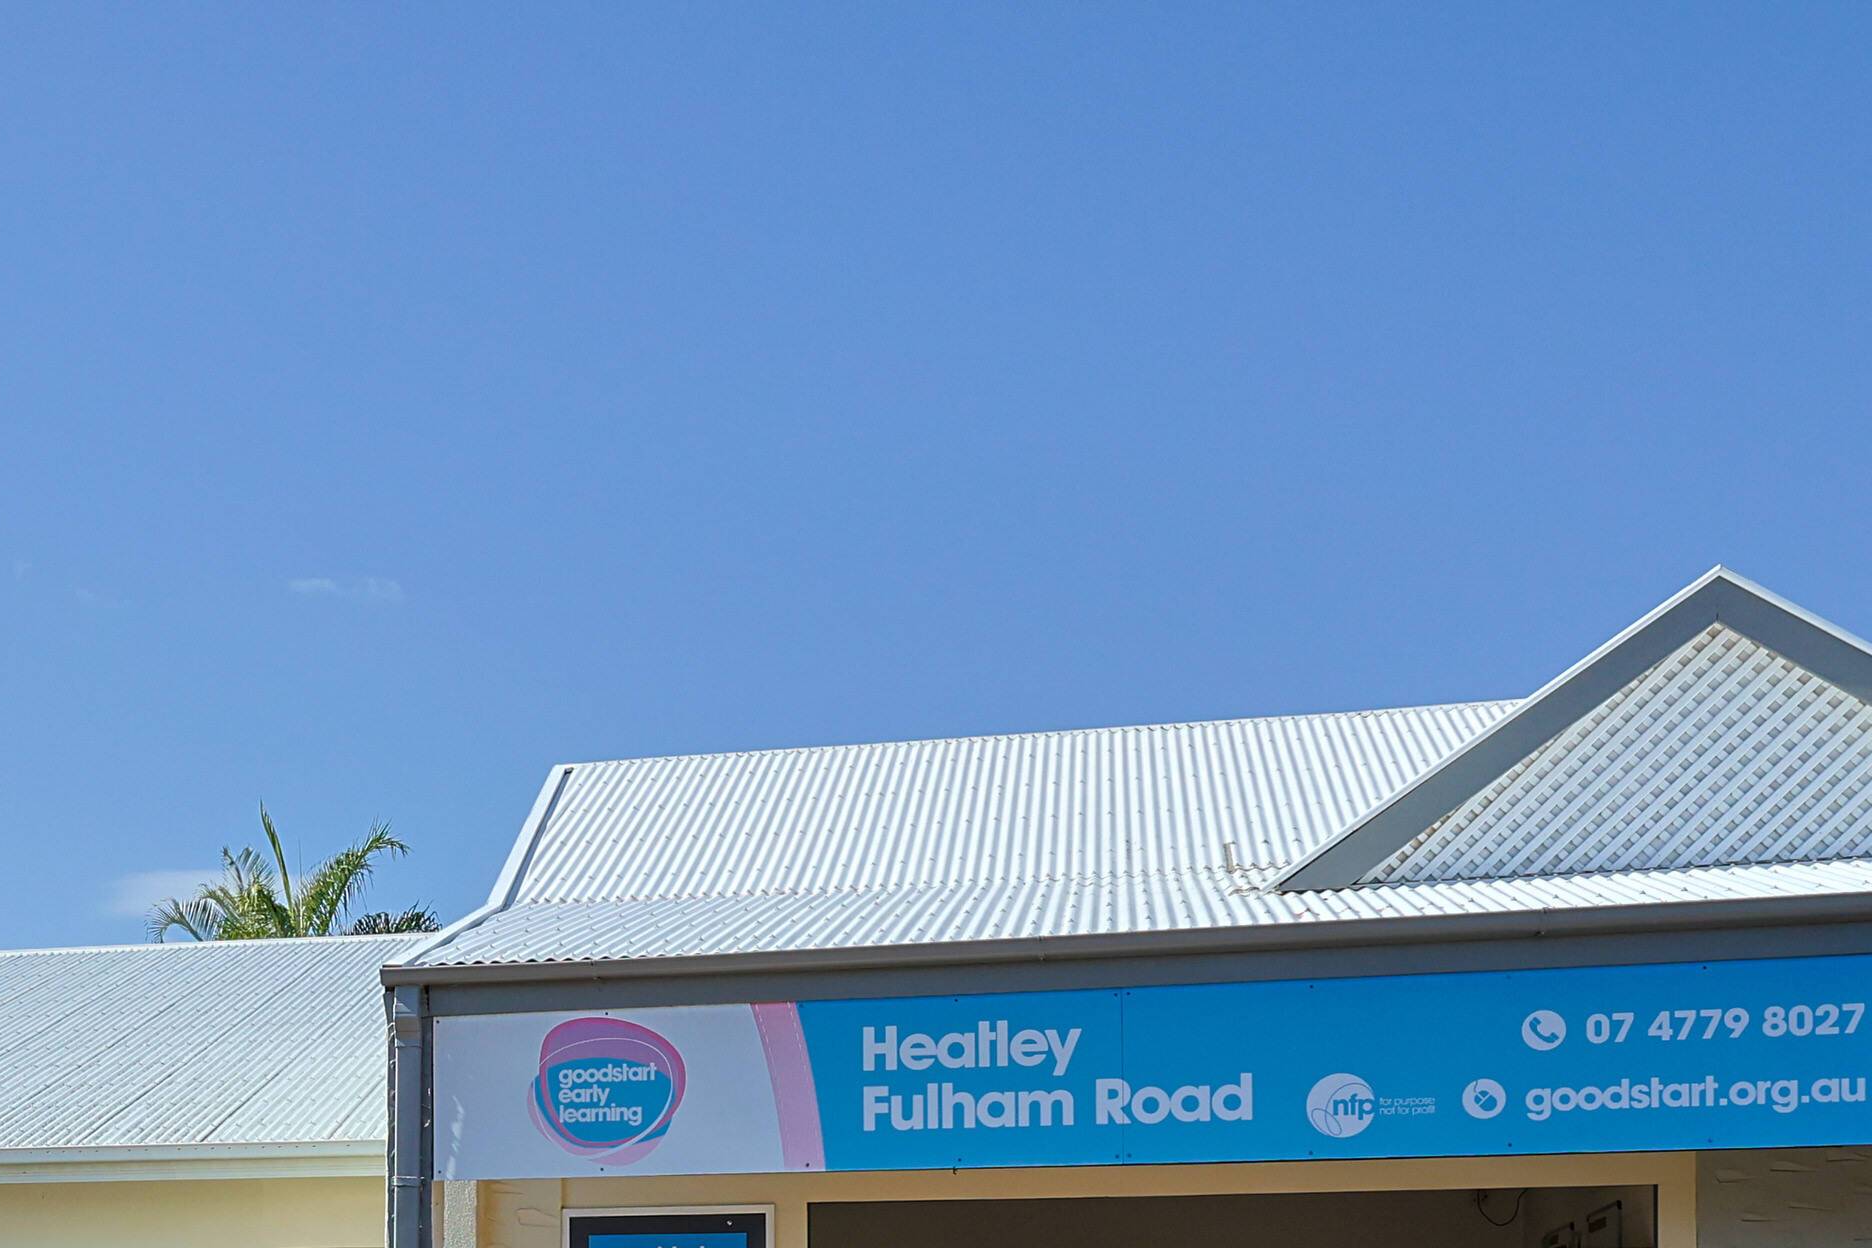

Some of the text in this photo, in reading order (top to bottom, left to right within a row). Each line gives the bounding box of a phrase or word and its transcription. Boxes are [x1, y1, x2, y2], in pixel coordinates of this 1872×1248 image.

[1586, 1003, 1866, 1045] 07 4779 8027
[862, 1019, 1083, 1077] Heatley
[558, 1062, 657, 1088] goodstart
[558, 1084, 610, 1106] early
[862, 1072, 1253, 1131] Fulham Road
[1332, 1093, 1375, 1121] nfp
[1525, 1075, 1867, 1122] goodstart.org.au
[559, 1103, 643, 1127] learning
